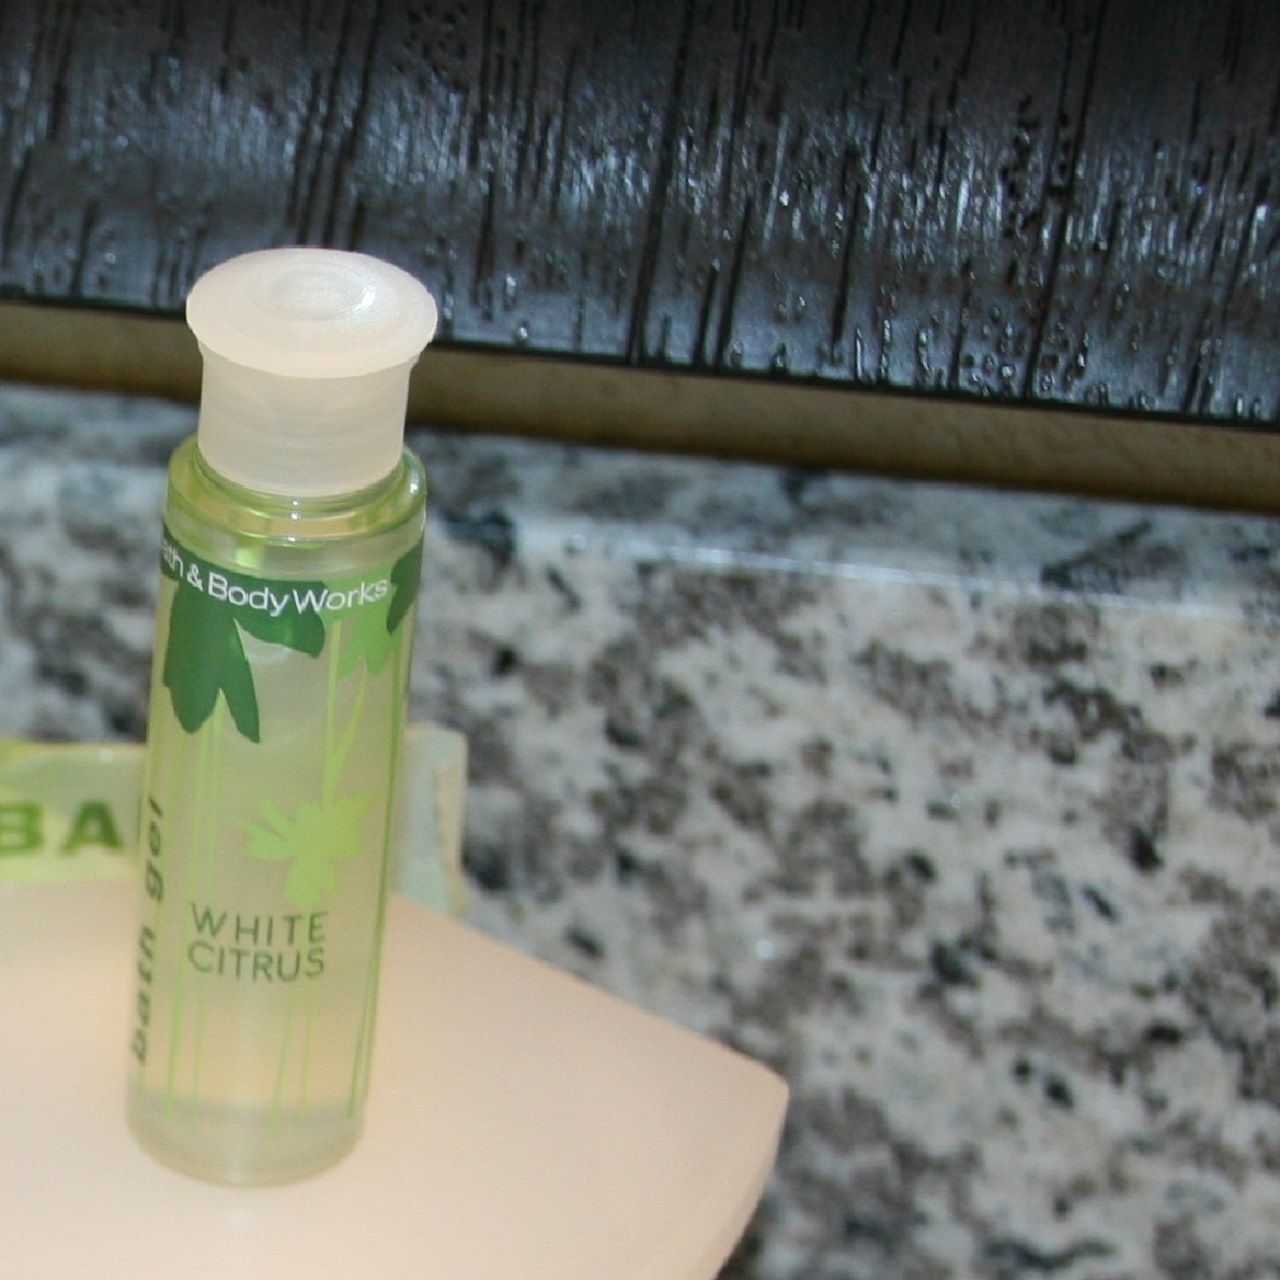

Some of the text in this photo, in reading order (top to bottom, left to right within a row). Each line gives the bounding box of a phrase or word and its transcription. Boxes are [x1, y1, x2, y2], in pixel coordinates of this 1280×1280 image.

[186, 563, 205, 592] &
[207, 572, 289, 617] Body
[292, 579, 389, 614] Works
[191, 901, 329, 946] WHITE
[187, 940, 326, 983] CITRUS
